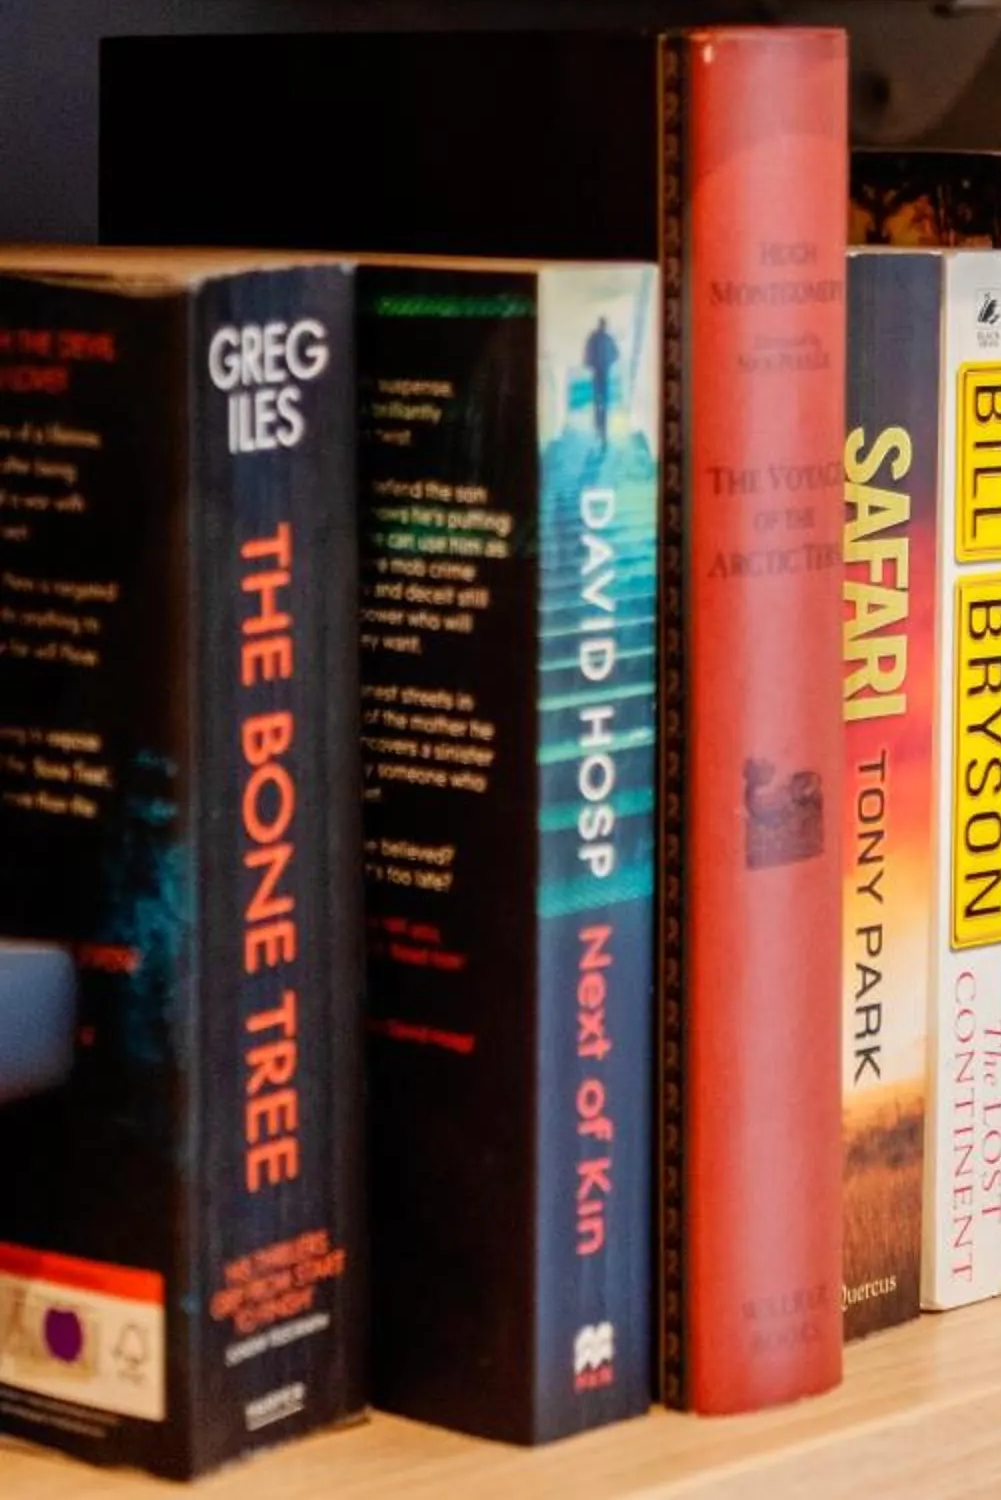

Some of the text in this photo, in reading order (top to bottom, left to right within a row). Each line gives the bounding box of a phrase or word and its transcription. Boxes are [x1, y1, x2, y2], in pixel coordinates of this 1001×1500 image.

[208, 318, 330, 391] GREG
[227, 389, 303, 454] ILES
[705, 461, 842, 497] THE VOYAG
[578, 487, 616, 879] DAVID HOSP
[844, 426, 913, 722] SAFARI
[240, 522, 298, 1194] THE BONE TREE
[853, 749, 888, 1086] TONY PARK
[575, 924, 612, 1256] Next of Kin
[951, 970, 977, 1284] CONTINENT
